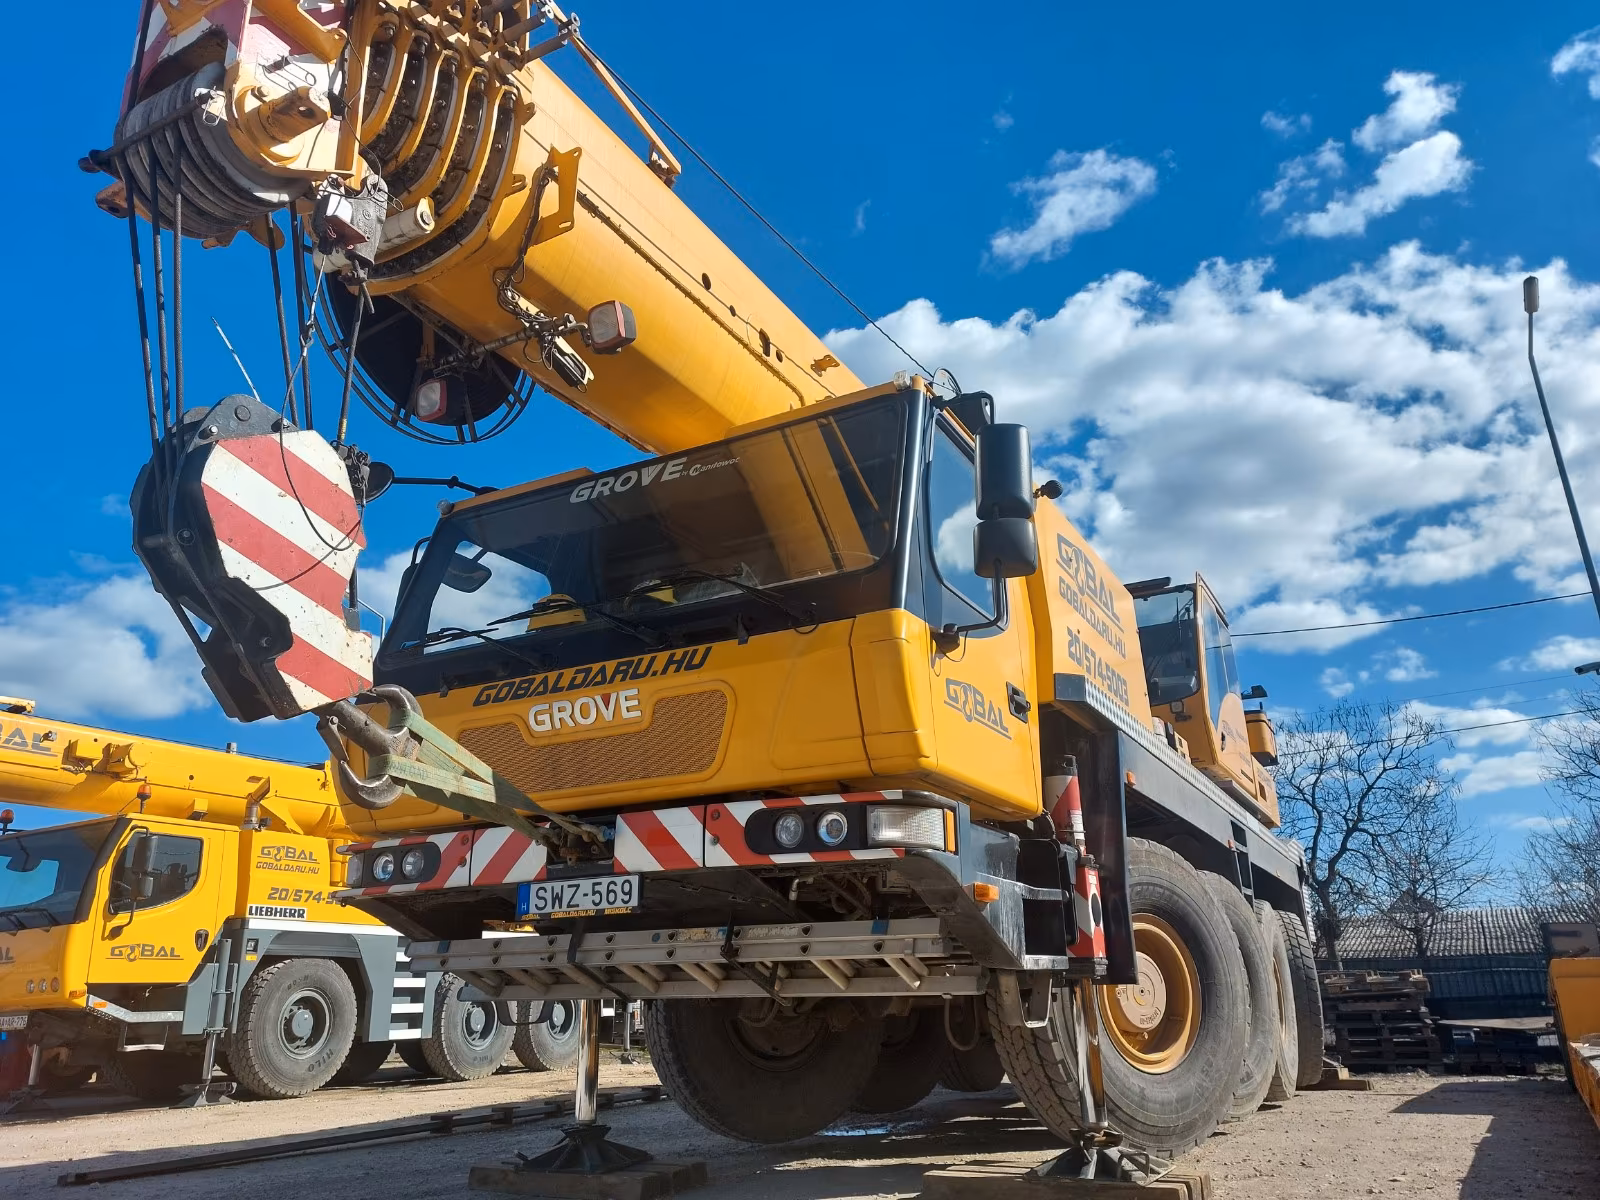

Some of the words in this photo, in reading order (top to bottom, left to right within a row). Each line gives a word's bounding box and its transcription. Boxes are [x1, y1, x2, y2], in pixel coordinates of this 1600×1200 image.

[569, 456, 688, 504] GROVE
[689, 457, 740, 476] Manitowoc
[1058, 575, 1127, 661] GOBALDARU.HU
[472, 646, 713, 707] GOBALDARU.HU
[528, 688, 642, 732] GROVE
[0, 723, 52, 752] AL
[256, 861, 321, 874] GOBALDARU.HU
[248, 905, 306, 919] LIEBHERR
[521, 902, 528, 911] H
[533, 879, 634, 912] SWZ-569
